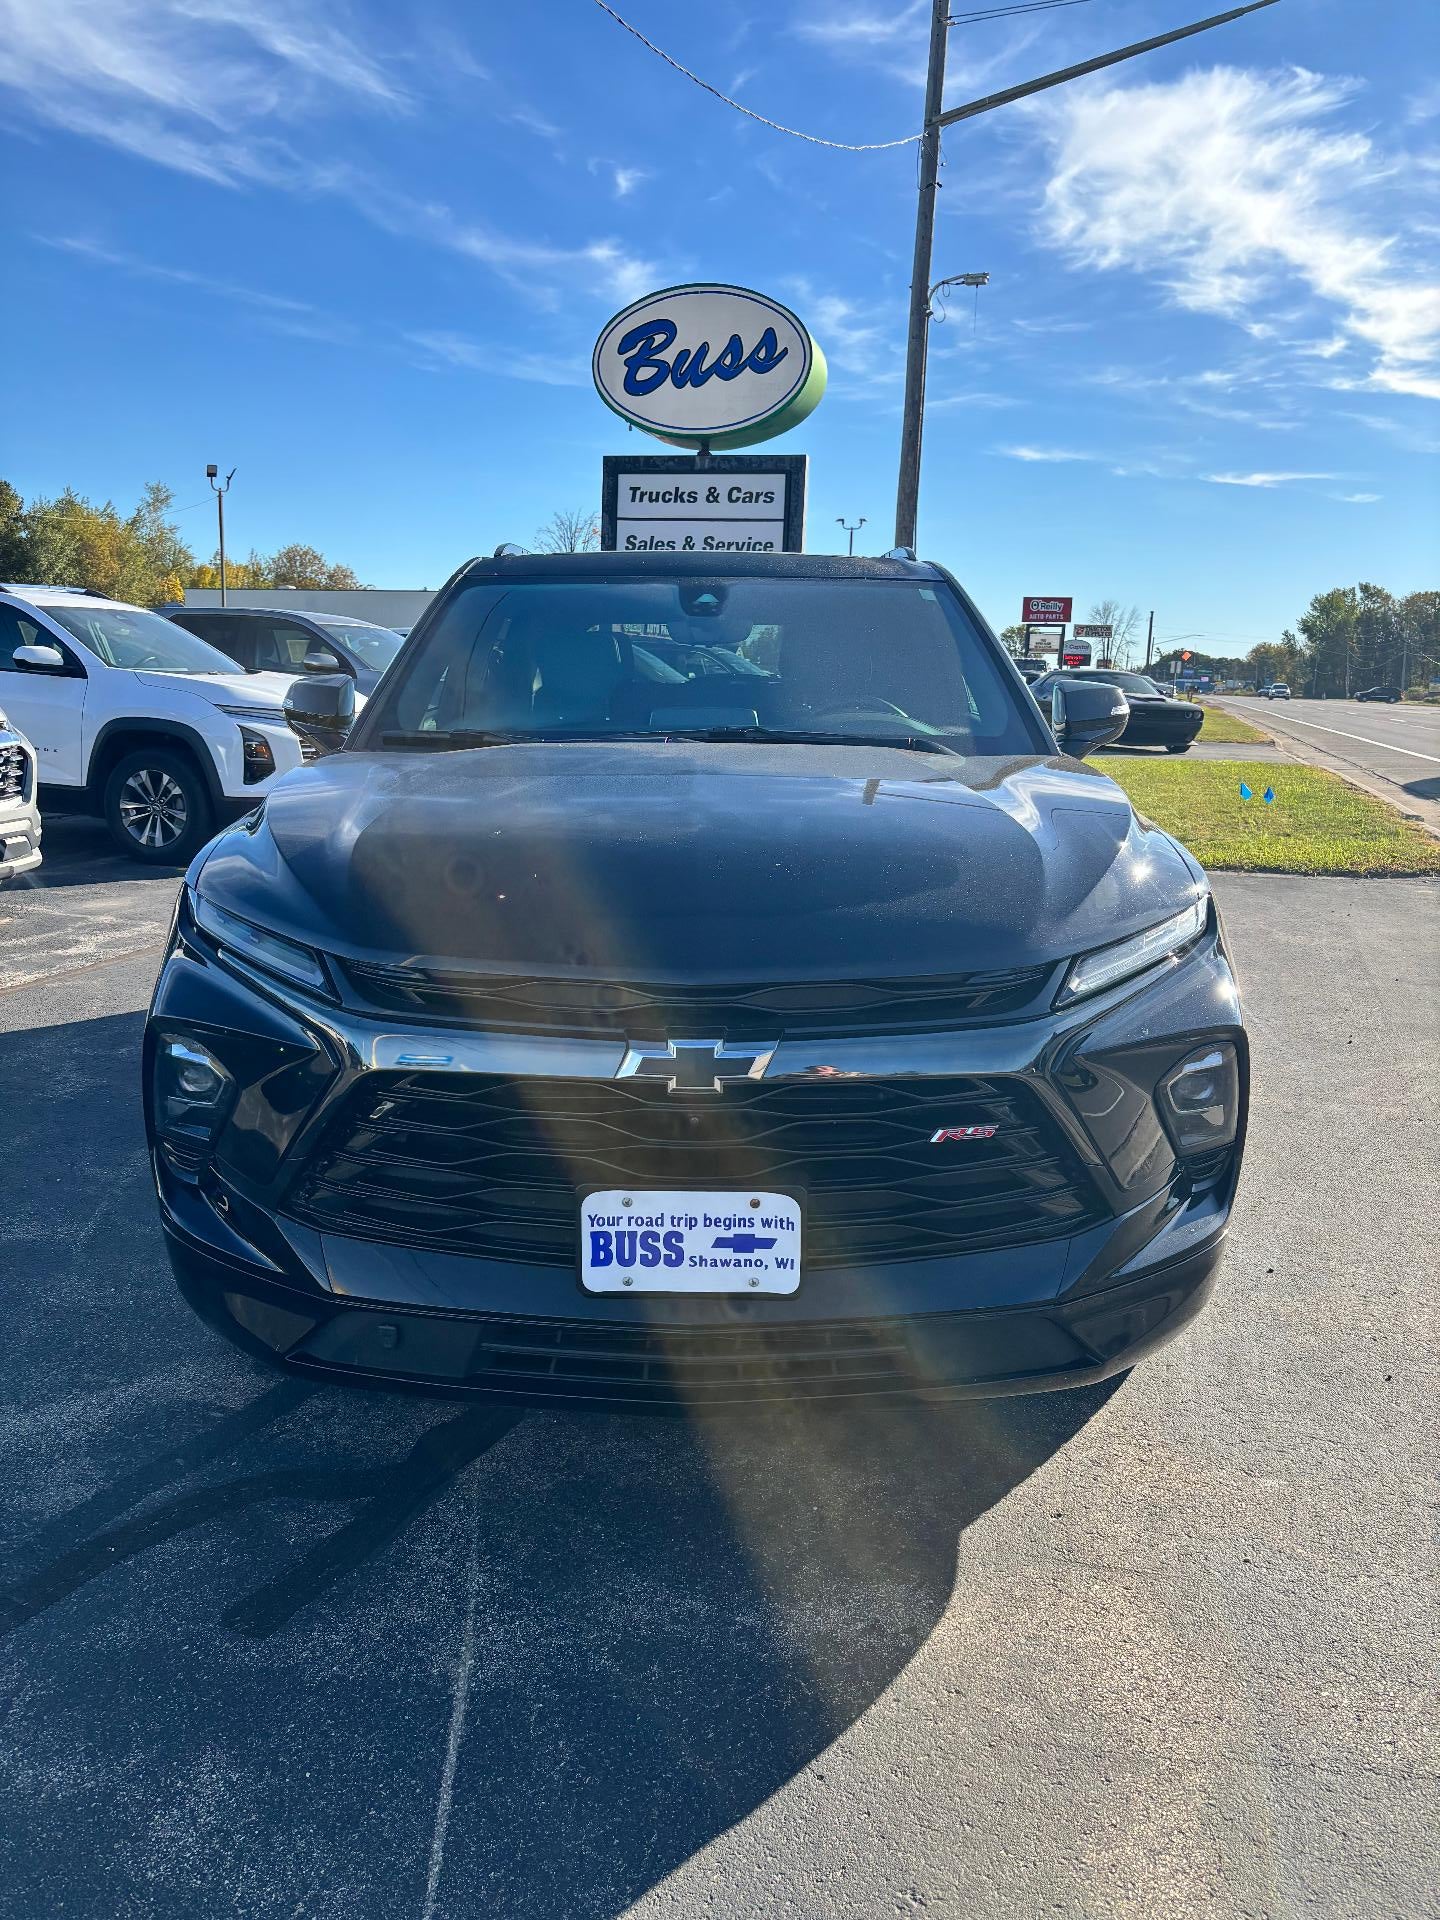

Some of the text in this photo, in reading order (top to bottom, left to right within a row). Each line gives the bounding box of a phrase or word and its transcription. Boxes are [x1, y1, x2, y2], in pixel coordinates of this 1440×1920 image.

[617, 318, 789, 397] Buss
[628, 486, 775, 504] Trucks & Cars
[624, 534, 774, 552] Sales & Service
[1030, 599, 1064, 612] O'Reilly
[929, 1124, 999, 1142] RS
[587, 1213, 795, 1231] Your road trip begins with
[590, 1230, 684, 1268] BUSS
[688, 1255, 795, 1271] Shawano, WI
